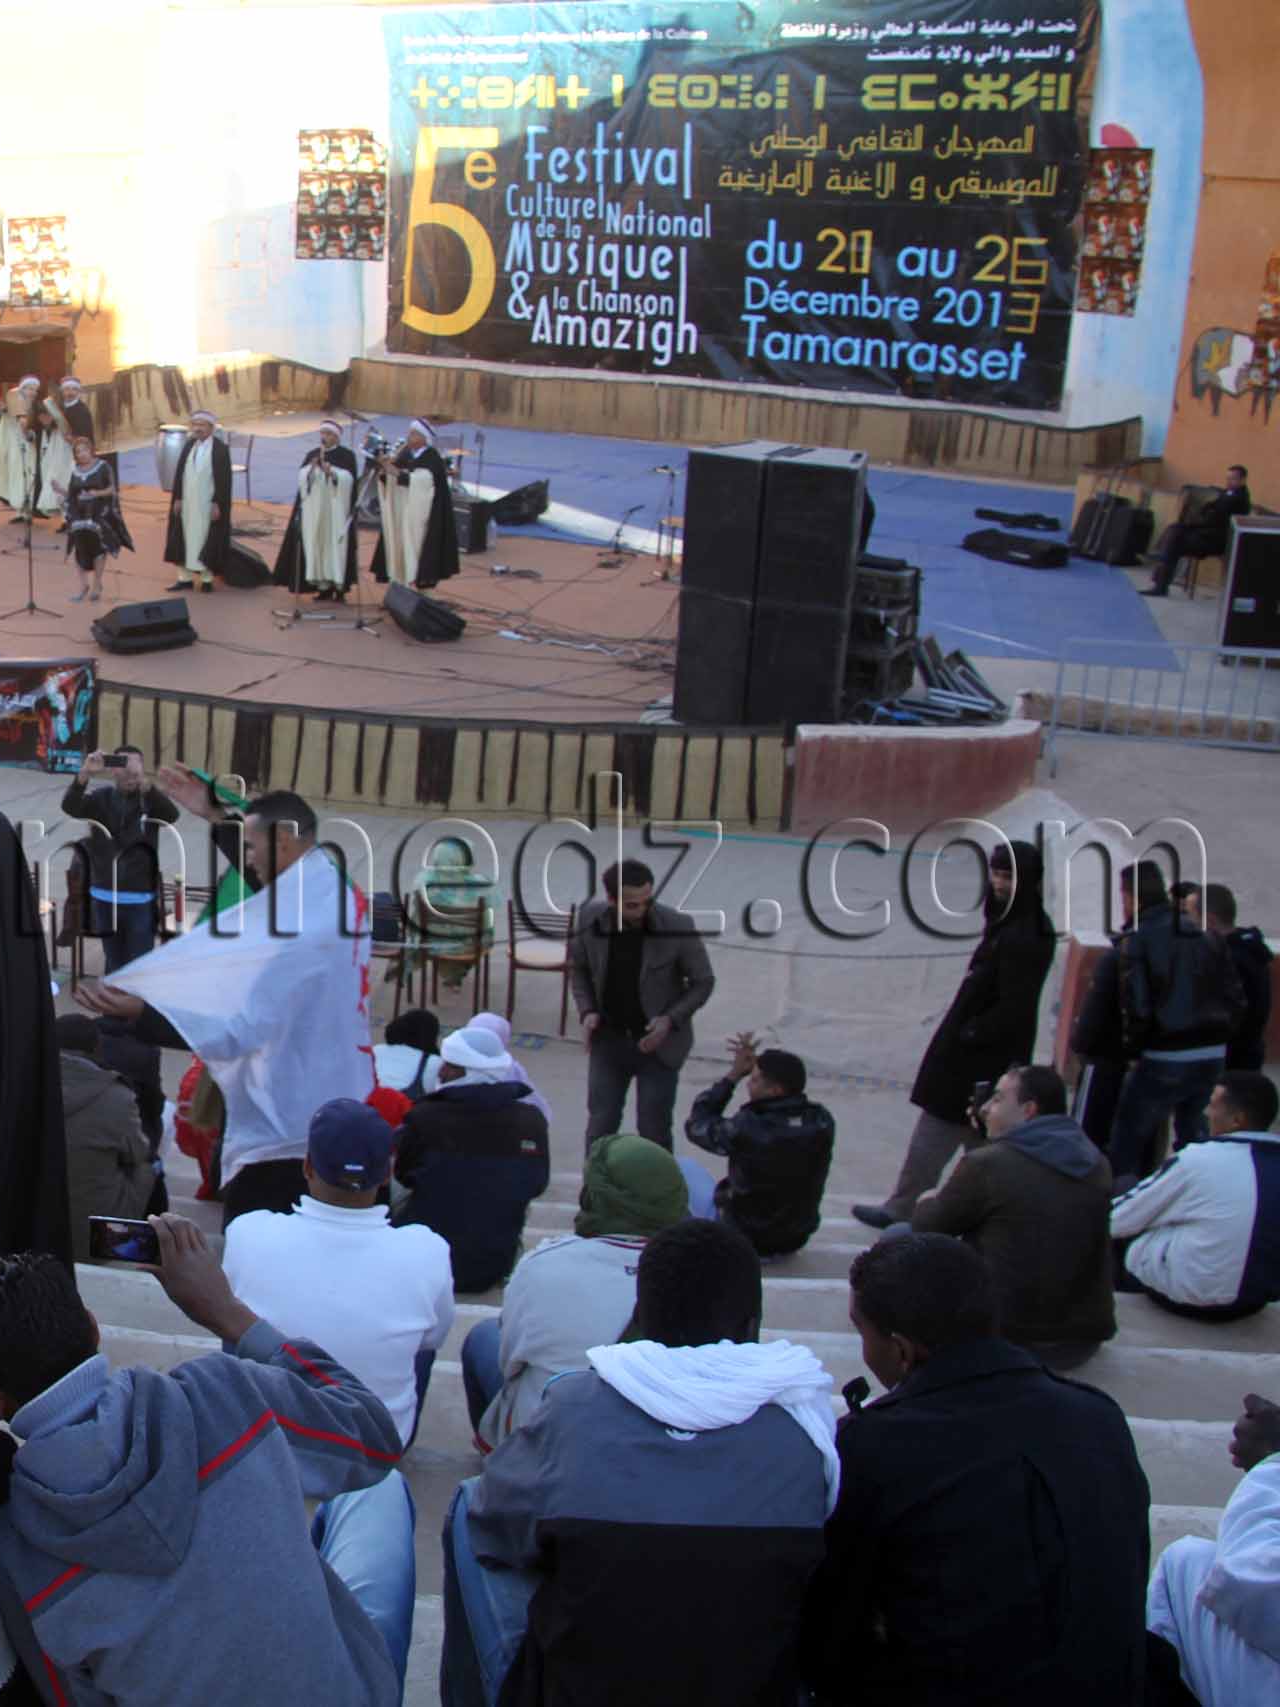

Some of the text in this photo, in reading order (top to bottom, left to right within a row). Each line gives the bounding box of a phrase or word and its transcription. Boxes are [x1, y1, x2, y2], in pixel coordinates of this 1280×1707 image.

[524, 121, 693, 200] Festival
[750, 123, 1035, 160] المهرجان الثقافي الوطني
[505, 182, 711, 239] Culturel National
[909, 174, 926, 200] و
[504, 221, 673, 290] Musique
[535, 215, 581, 239] de la
[745, 218, 804, 271] du
[896, 246, 958, 279] au
[506, 271, 675, 320] & la Chanson
[531, 247, 699, 367] Amazigh
[744, 276, 1041, 335] Décembre 2013
[740, 314, 1027, 382] Tamanrasset
